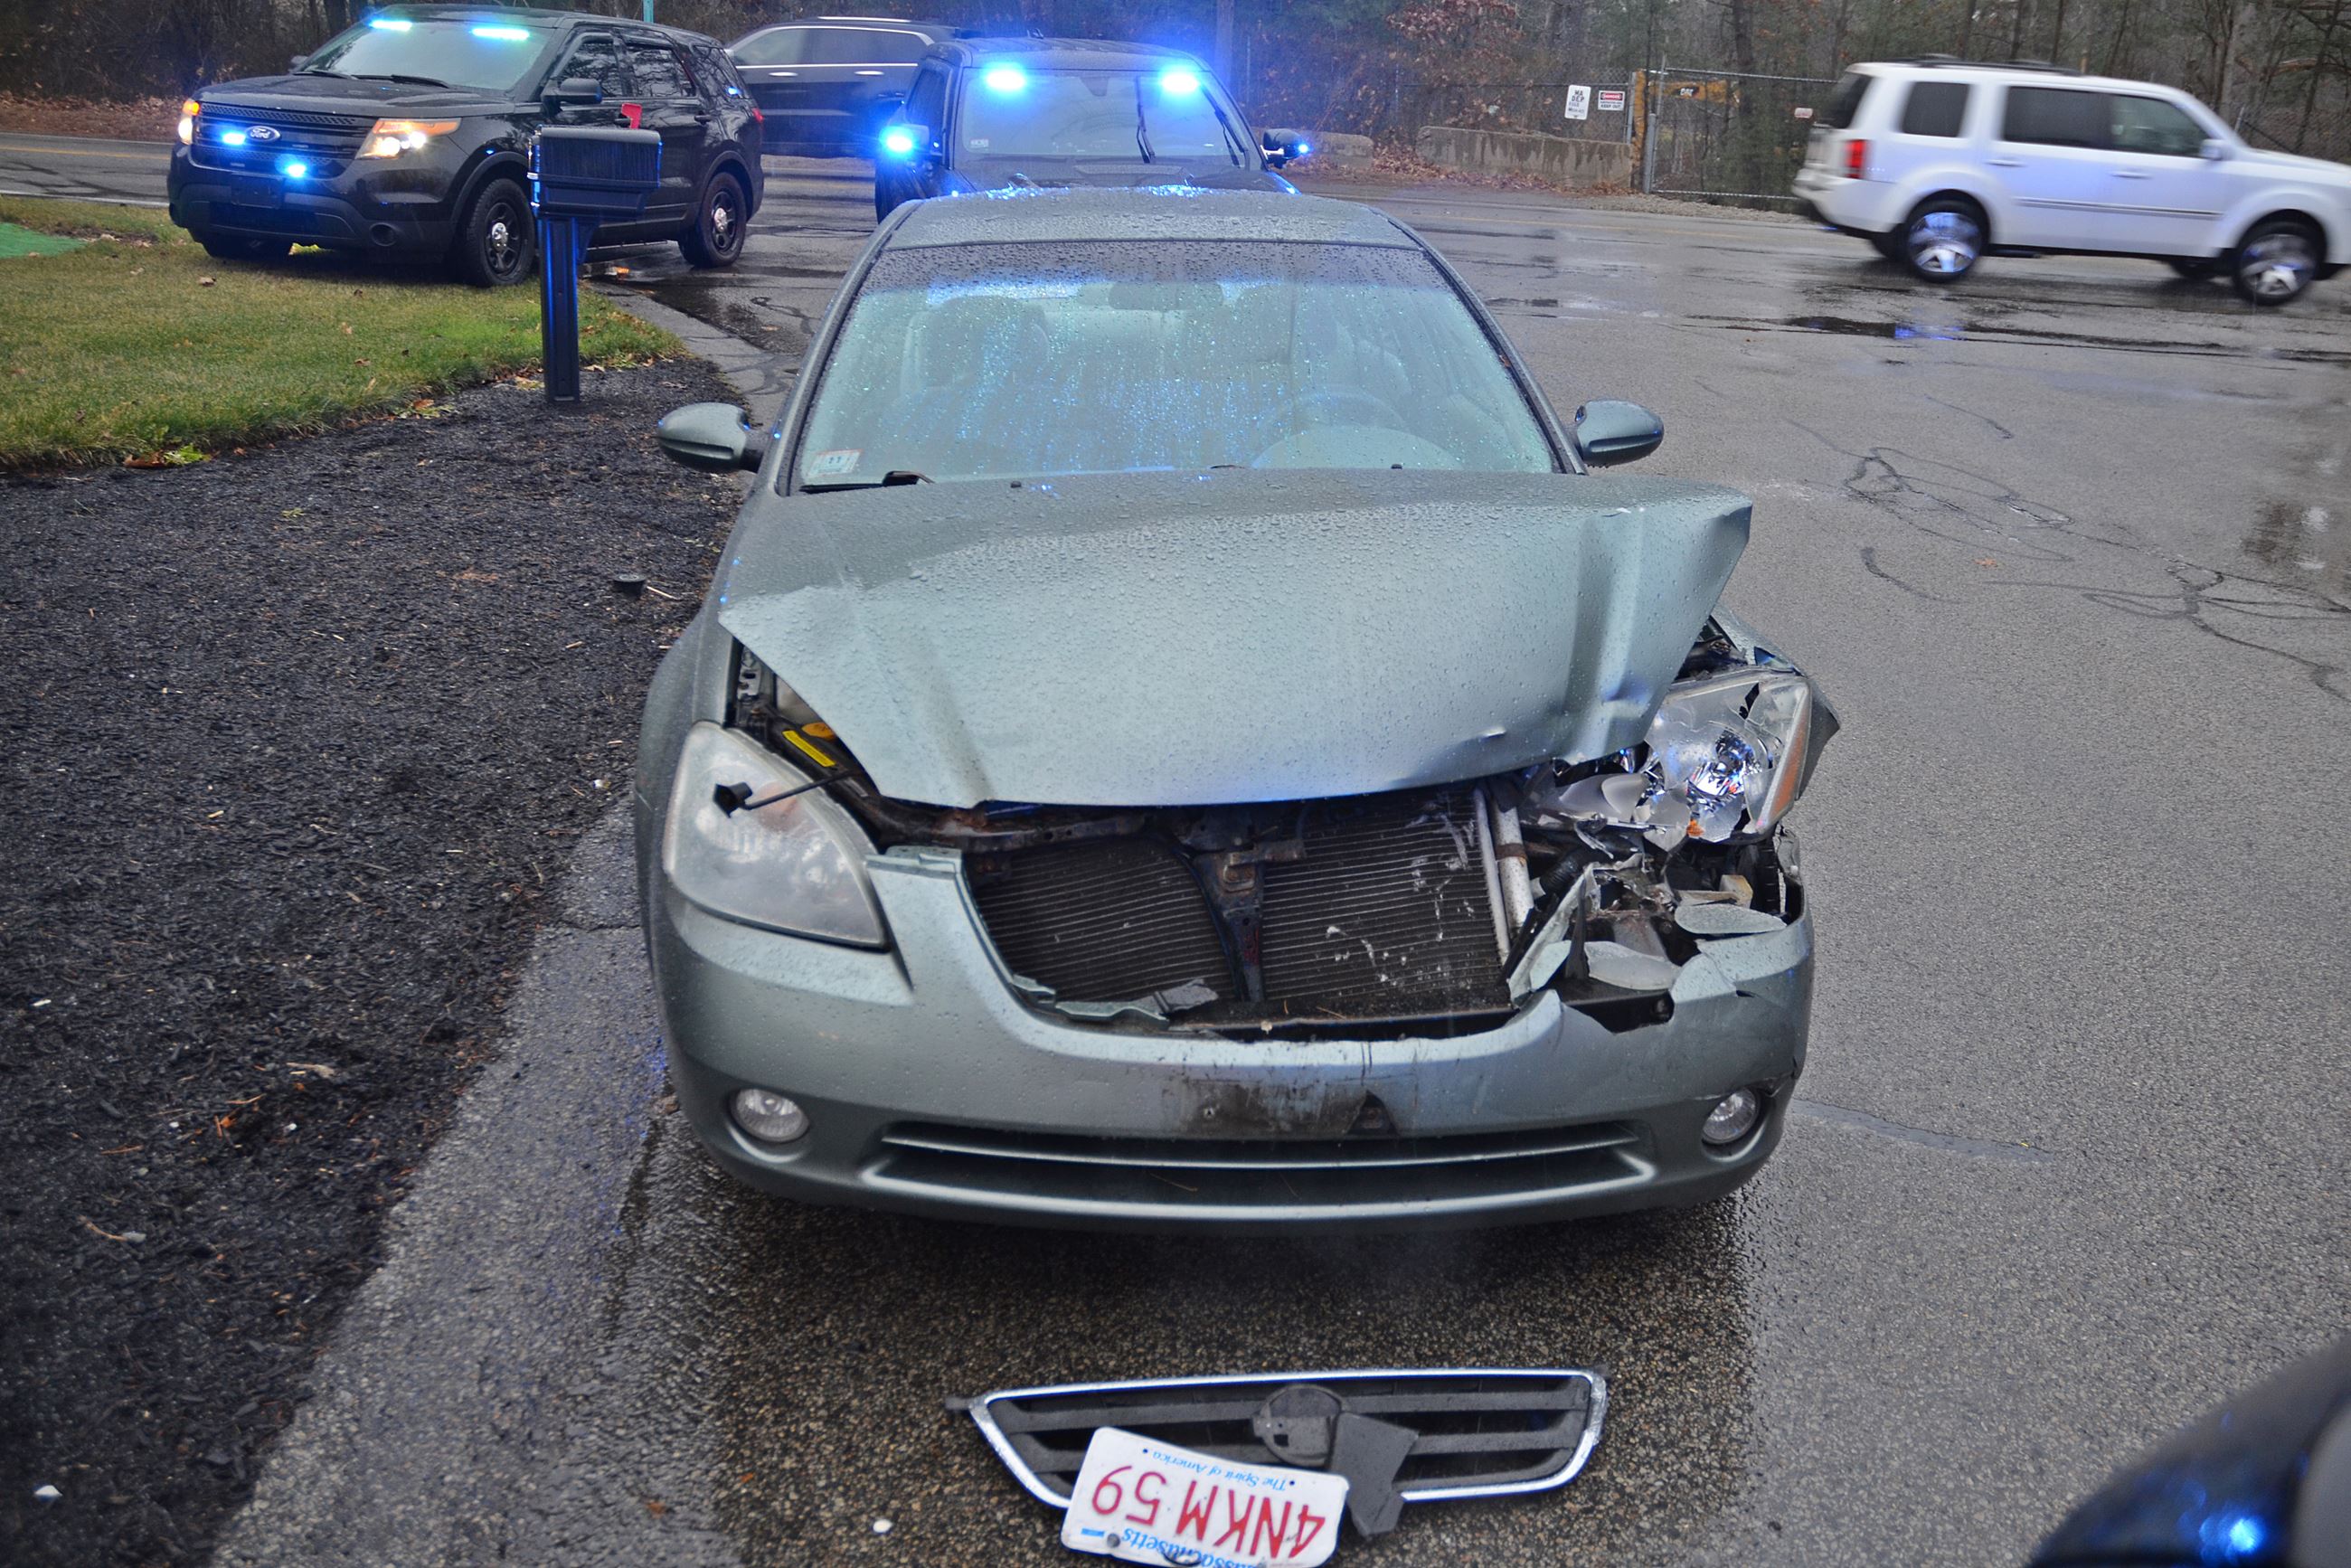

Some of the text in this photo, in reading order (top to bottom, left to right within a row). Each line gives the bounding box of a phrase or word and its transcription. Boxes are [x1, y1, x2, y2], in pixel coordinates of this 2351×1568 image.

[1152, 1450, 1287, 1491] The Spirit of America
[1091, 1465, 1326, 1559] 4NKM 59
[1121, 1527, 1256, 1568] ssacusetts
